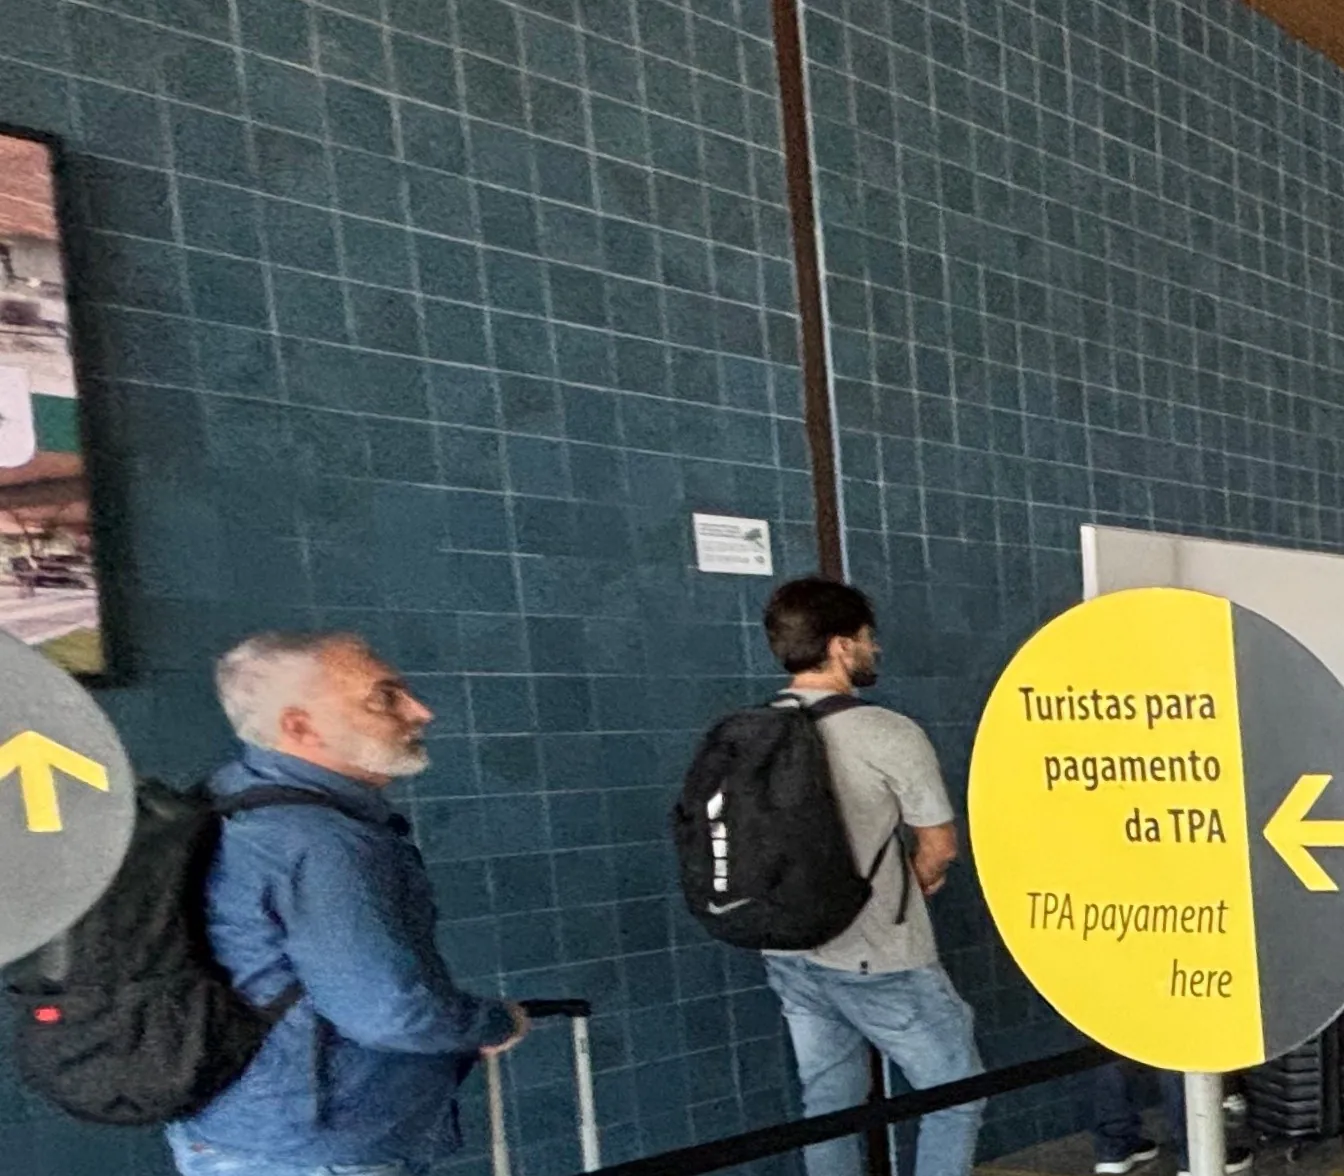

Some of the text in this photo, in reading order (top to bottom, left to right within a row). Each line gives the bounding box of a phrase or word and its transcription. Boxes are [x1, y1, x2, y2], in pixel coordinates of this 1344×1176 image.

[1018, 685, 1216, 730] Turistas para
[1044, 750, 1221, 792] pagamento
[1125, 807, 1227, 844] da TPA
[1026, 892, 1229, 943] TPA payament
[1170, 958, 1233, 999] here
